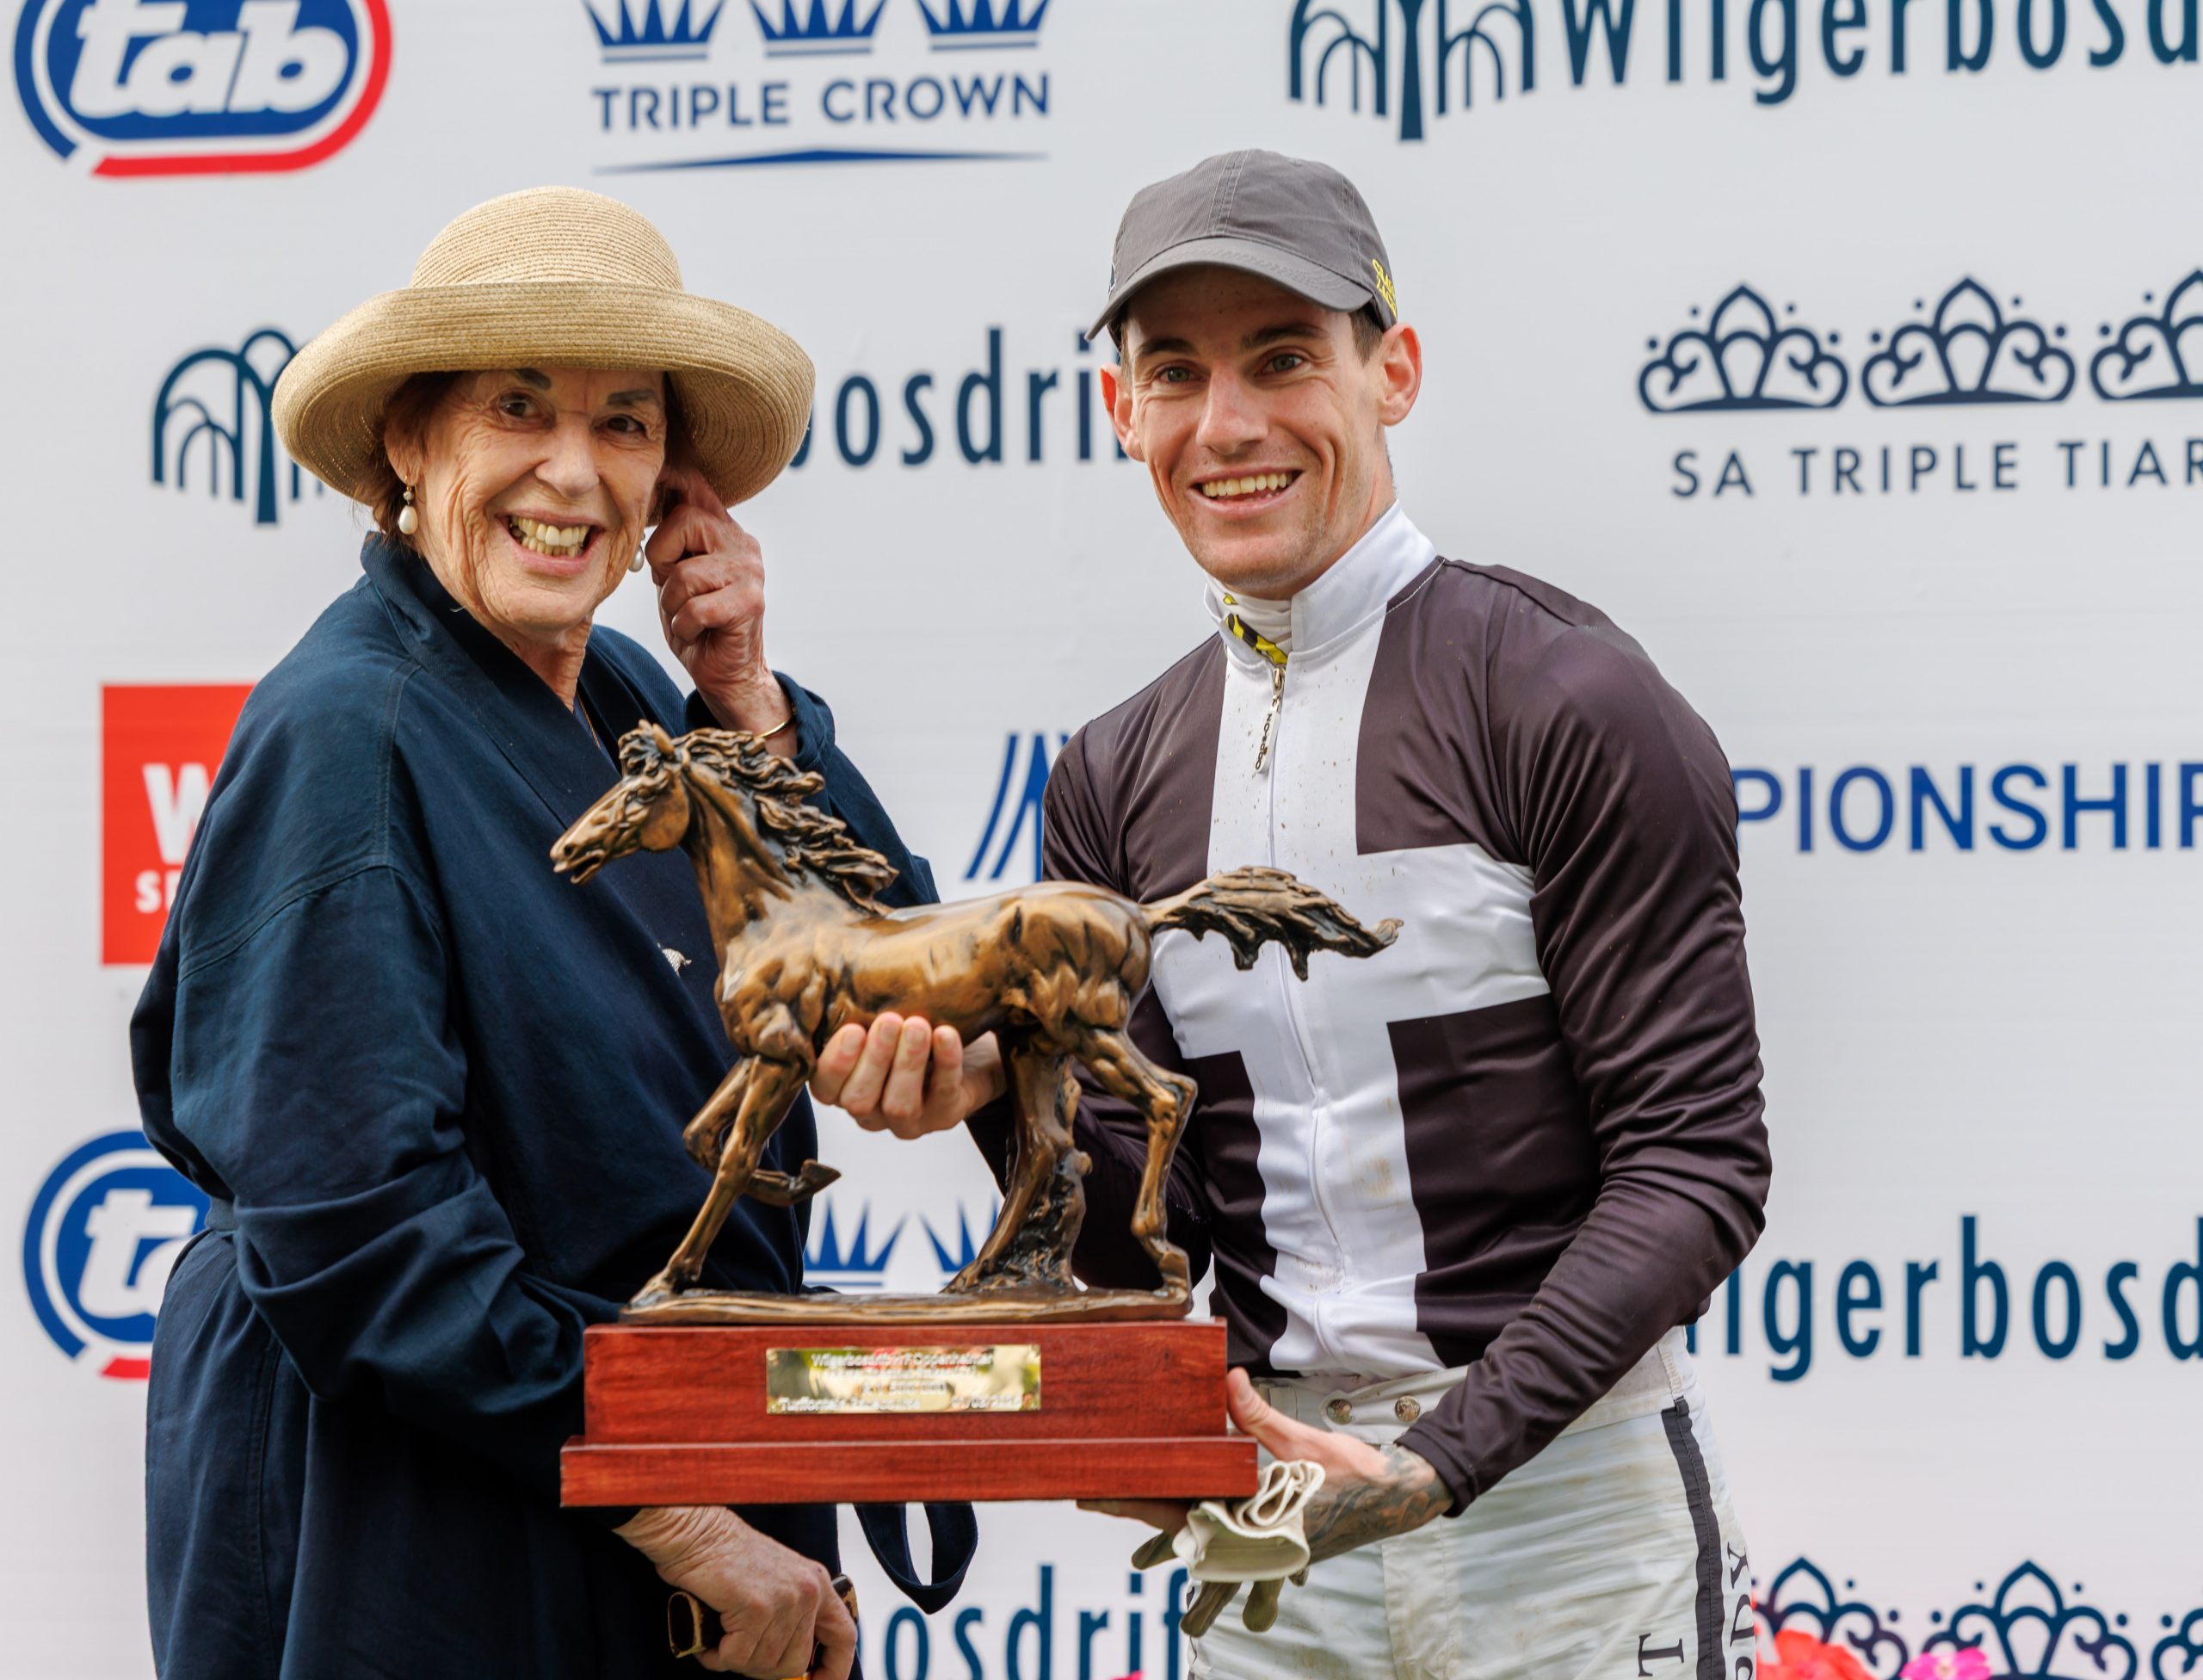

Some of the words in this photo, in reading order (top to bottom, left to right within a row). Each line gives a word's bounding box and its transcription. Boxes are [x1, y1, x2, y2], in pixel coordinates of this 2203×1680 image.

[69, 0, 350, 119] tab
[592, 81, 790, 133] TRIPLE
[820, 72, 1051, 123] CROWN
[788, 327, 1126, 468] osdri
[1670, 448, 1756, 498] SA
[1791, 442, 2020, 496] TRIPLE
[2055, 437, 2203, 489] TIAR
[1687, 1214, 2203, 1382] lgerbosd
[856, 1563, 1188, 1680] osdrif
